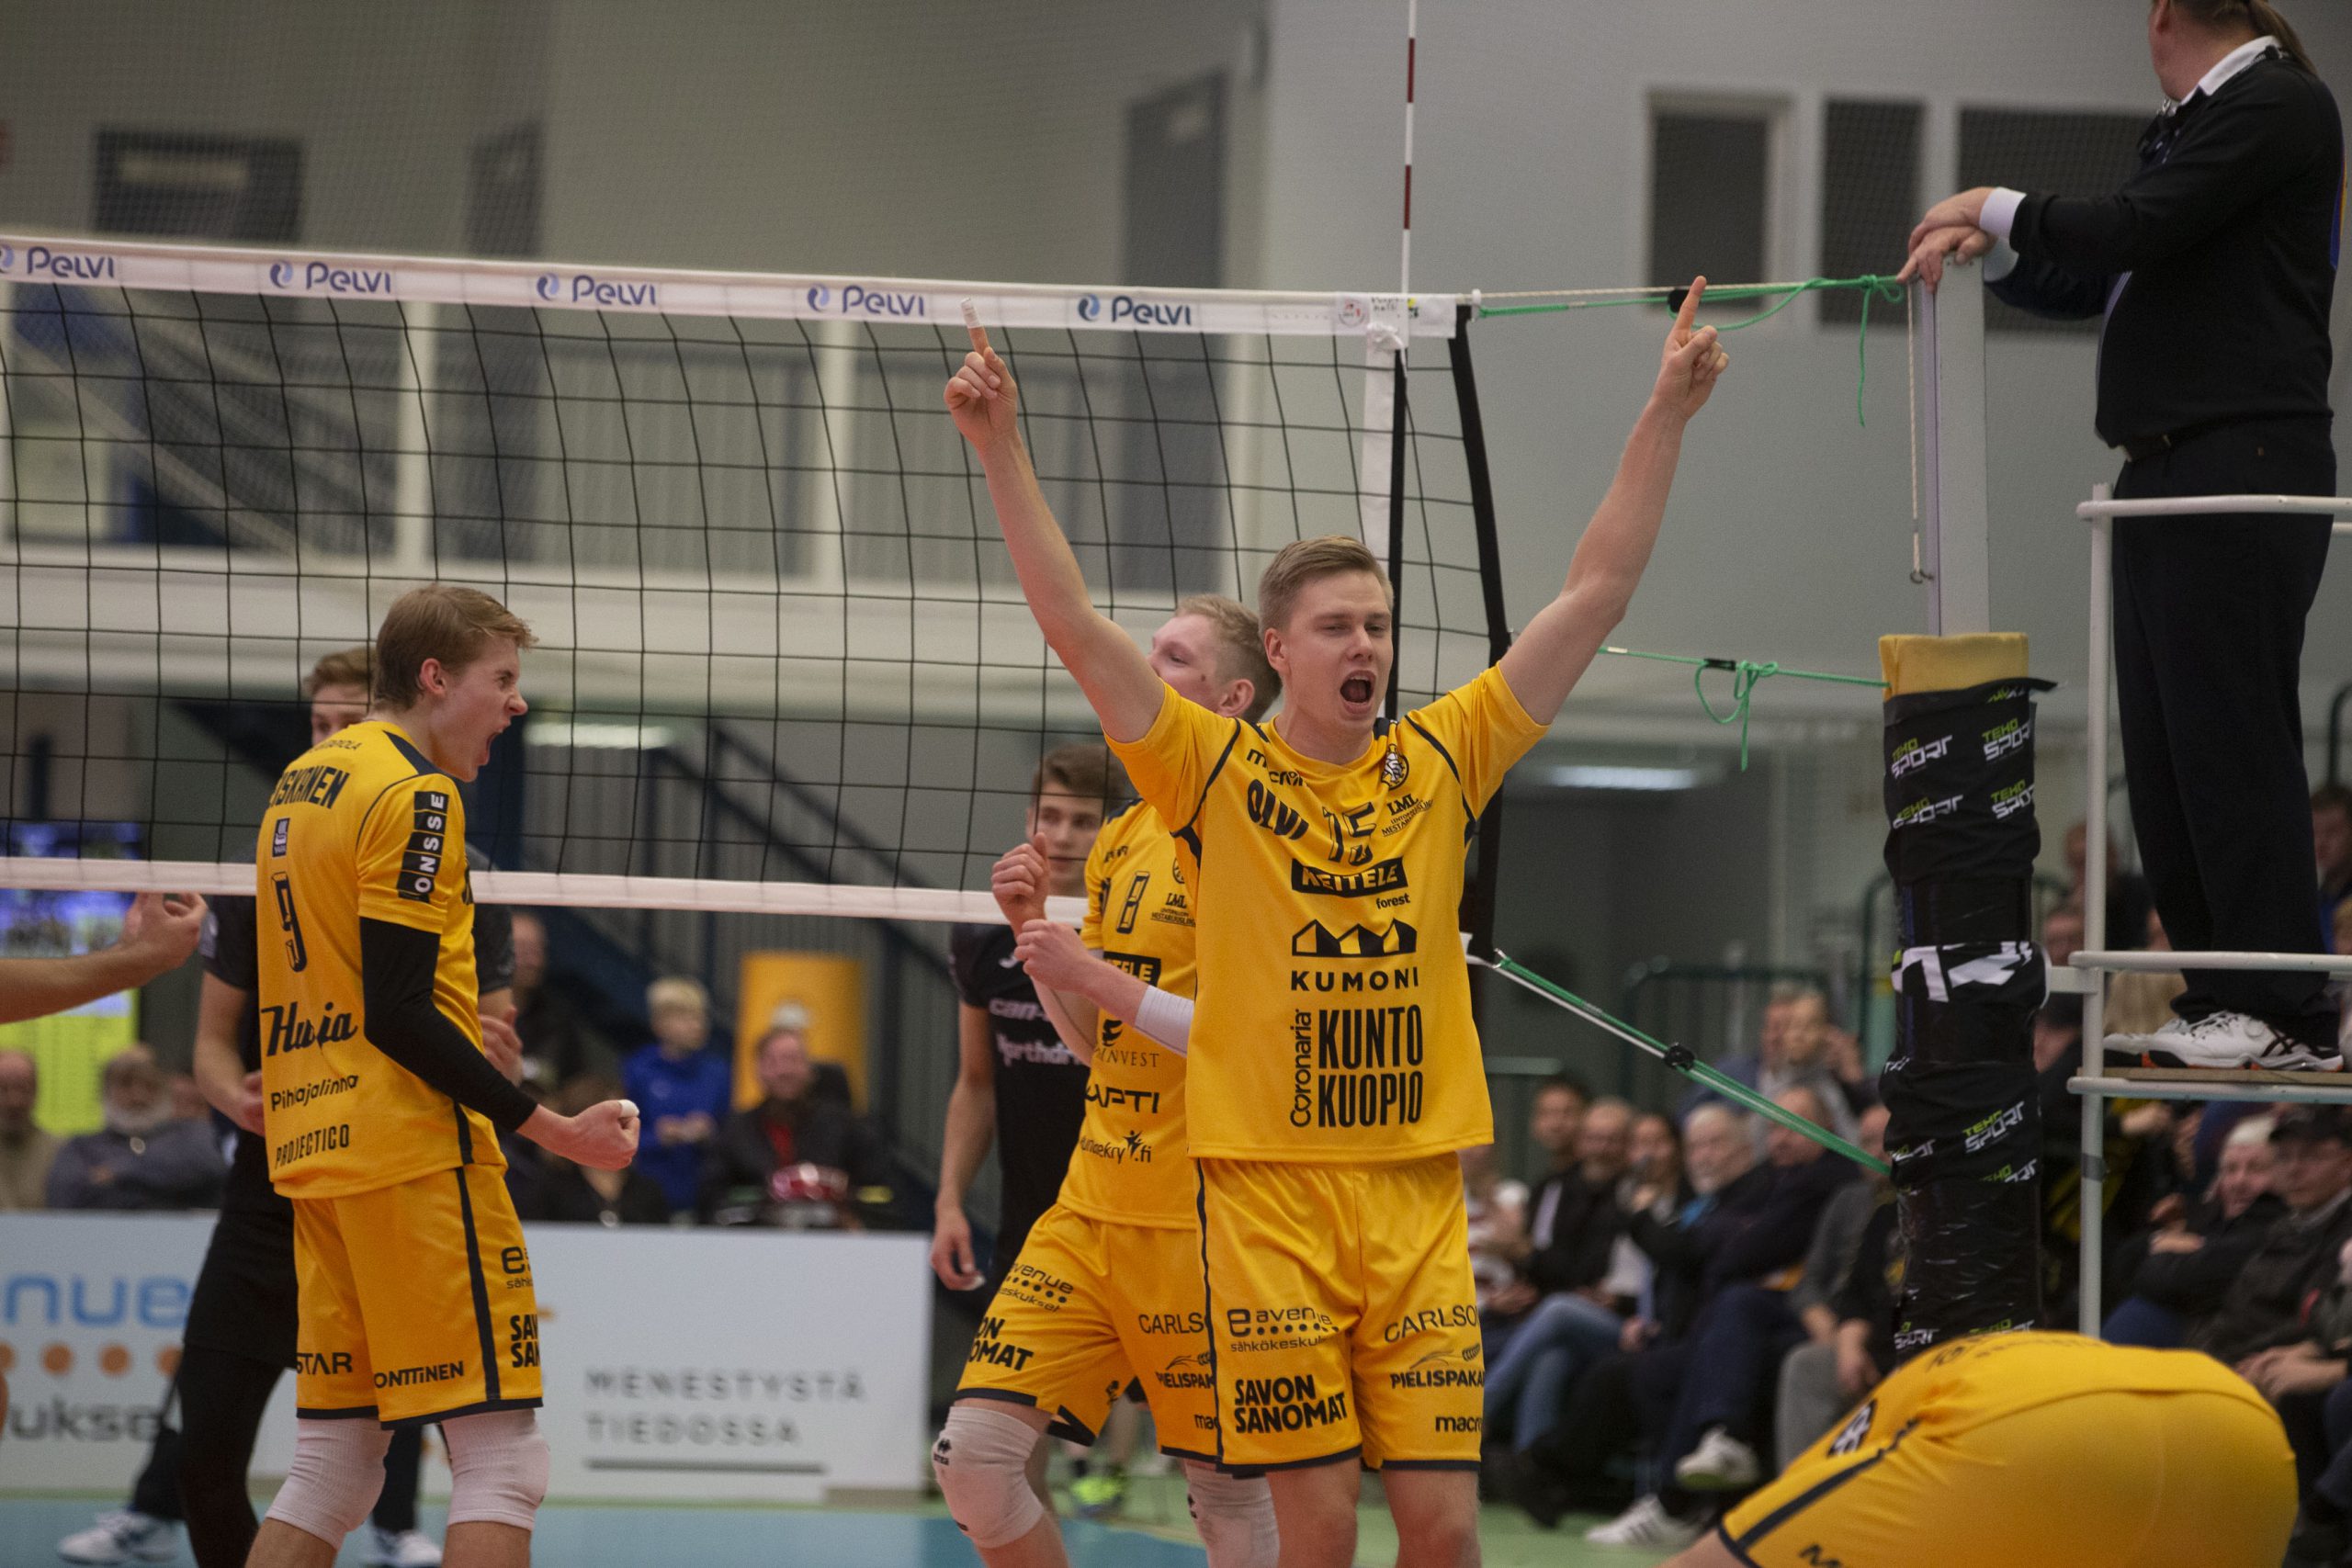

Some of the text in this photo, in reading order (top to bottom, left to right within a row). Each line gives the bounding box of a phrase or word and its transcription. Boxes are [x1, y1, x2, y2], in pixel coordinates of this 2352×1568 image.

[1982, 716, 2019, 743] TEHO
[1891, 734, 1953, 780] SPORT
[1386, 793, 1419, 816] LML
[1990, 778, 2027, 803] TEHO
[1375, 892, 1411, 909] forest
[271, 872, 308, 973] 9
[1290, 966, 1419, 992] KUMONI
[1317, 1004, 1424, 1070] KUNTO
[1317, 1070, 1424, 1128] KUOPIO
[275, 1123, 350, 1169] PROJECTICO
[1138, 1312, 1206, 1335] CARLS
[1384, 1304, 1480, 1344] CARLSO
[1235, 1374, 1317, 1407] SAVON
[1389, 1370, 1485, 1390] PIELISPAKA
[585, 1411, 801, 1446] TIEDOSSA
[1234, 1392, 1349, 1434] SANOMAT
